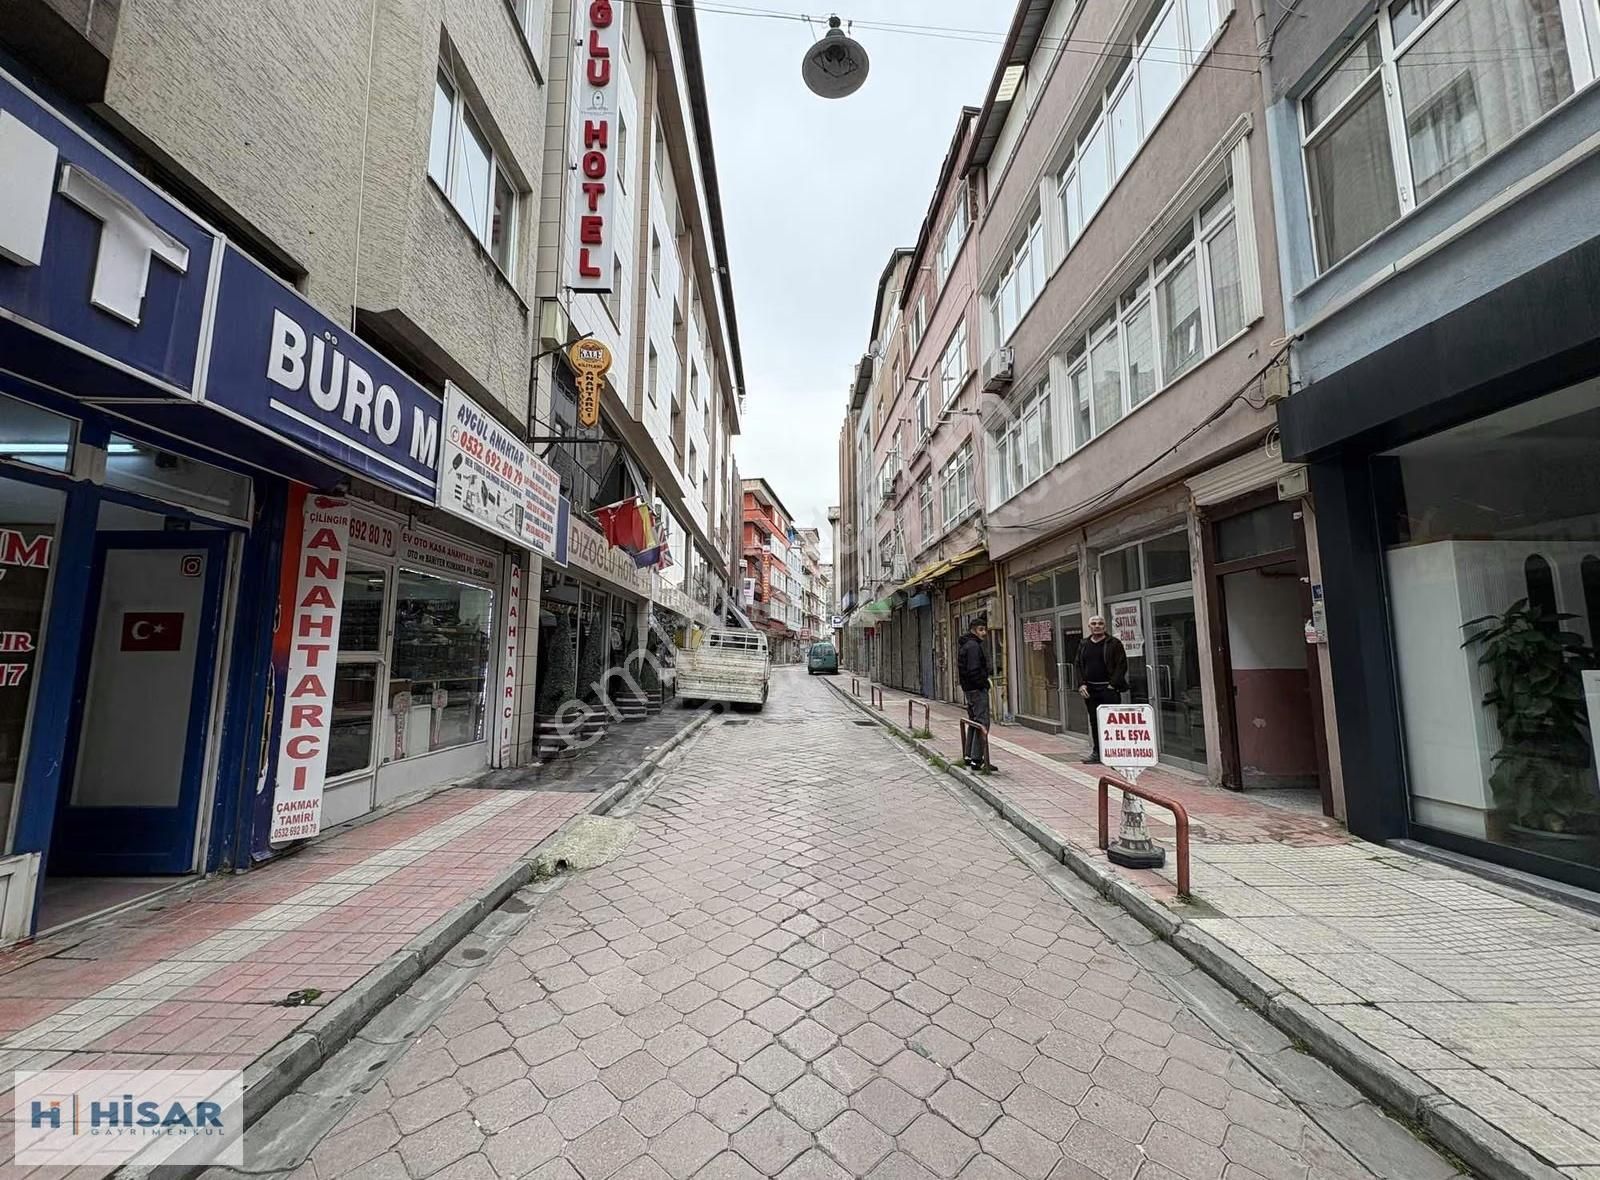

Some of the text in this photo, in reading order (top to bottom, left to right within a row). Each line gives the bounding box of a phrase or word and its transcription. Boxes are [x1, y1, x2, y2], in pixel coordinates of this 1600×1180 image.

[580, 120, 608, 277] HOTEL
[267, 308, 439, 471] BÜRO M
[586, 371, 594, 417] ANAHTARCI
[457, 404, 525, 469] AYGÜL ANAHTAR
[460, 431, 484, 460] 0532
[485, 449, 501, 472] 692
[502, 461, 513, 480] 80
[514, 469, 523, 486] 79
[349, 518, 392, 549] 692 80 79
[429, 541, 446, 555] KASA
[407, 549, 418, 560] OTO
[286, 528, 341, 791] ANAHTARCI
[504, 566, 519, 740] ANAHTARCI
[1107, 712, 1146, 724] ANIL
[1104, 729, 1151, 744] 2. EL EŞYA
[1133, 748, 1153, 758] BORSASI
[276, 799, 319, 815] ÇAKMAK
[280, 810, 314, 825] TAMİRİ
